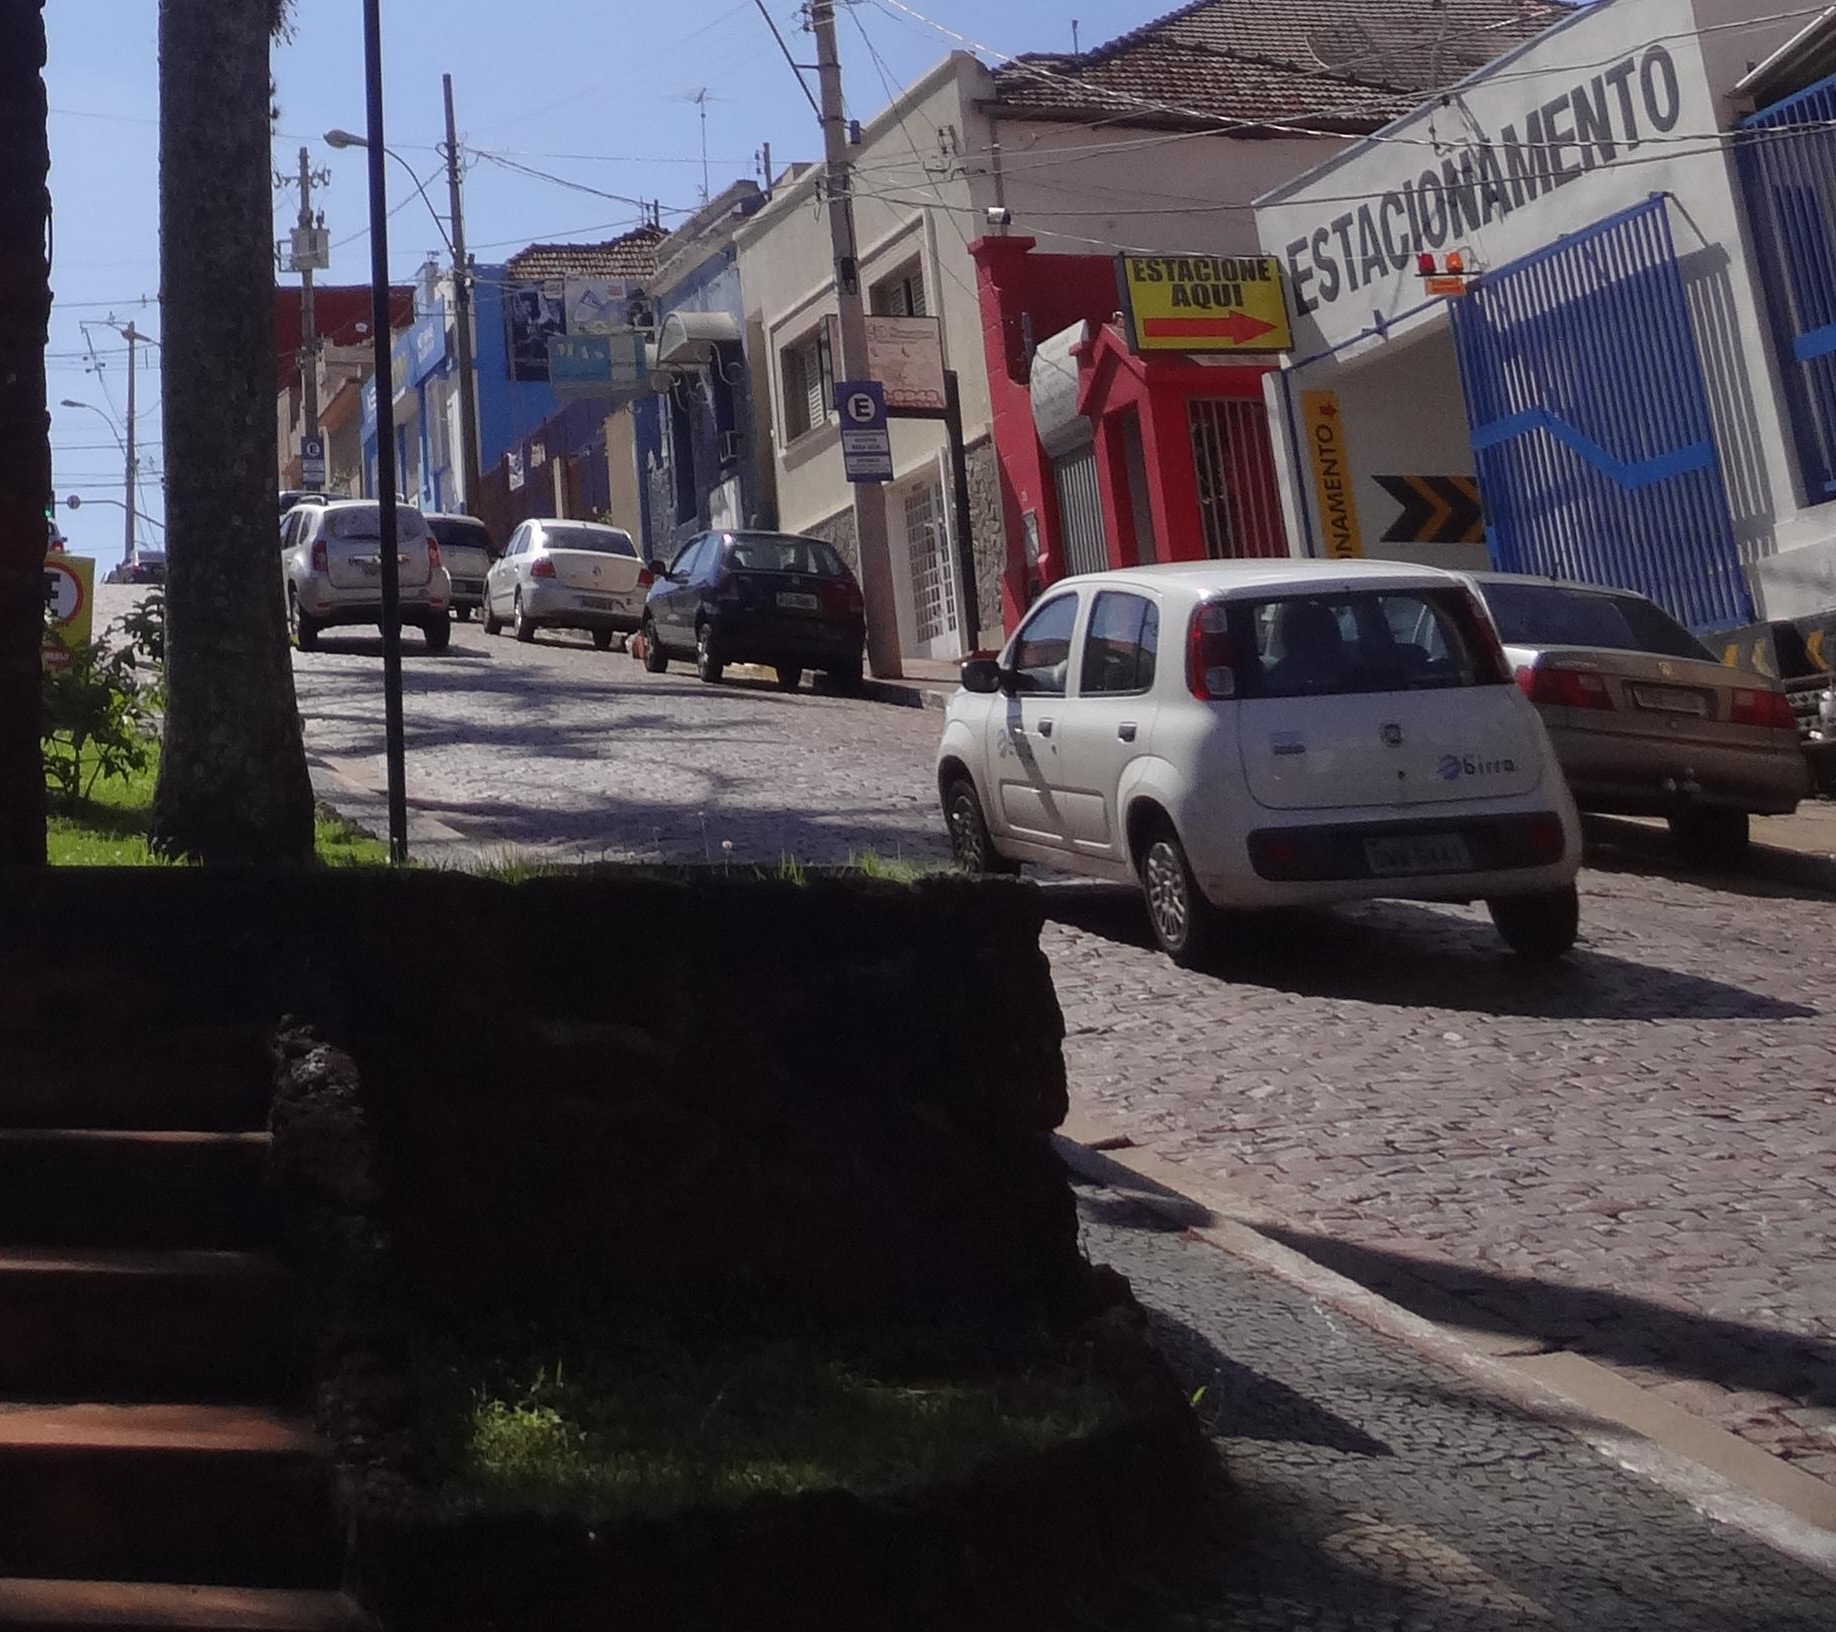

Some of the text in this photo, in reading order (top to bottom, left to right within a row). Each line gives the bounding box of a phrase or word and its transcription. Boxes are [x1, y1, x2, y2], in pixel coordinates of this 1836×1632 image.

[1285, 44, 1680, 317] ESTACIONAMENTO
[1131, 258, 1272, 282] ESTACIONE
[1171, 283, 1245, 309] AQUI
[1315, 424, 1354, 558] NAMENTO
